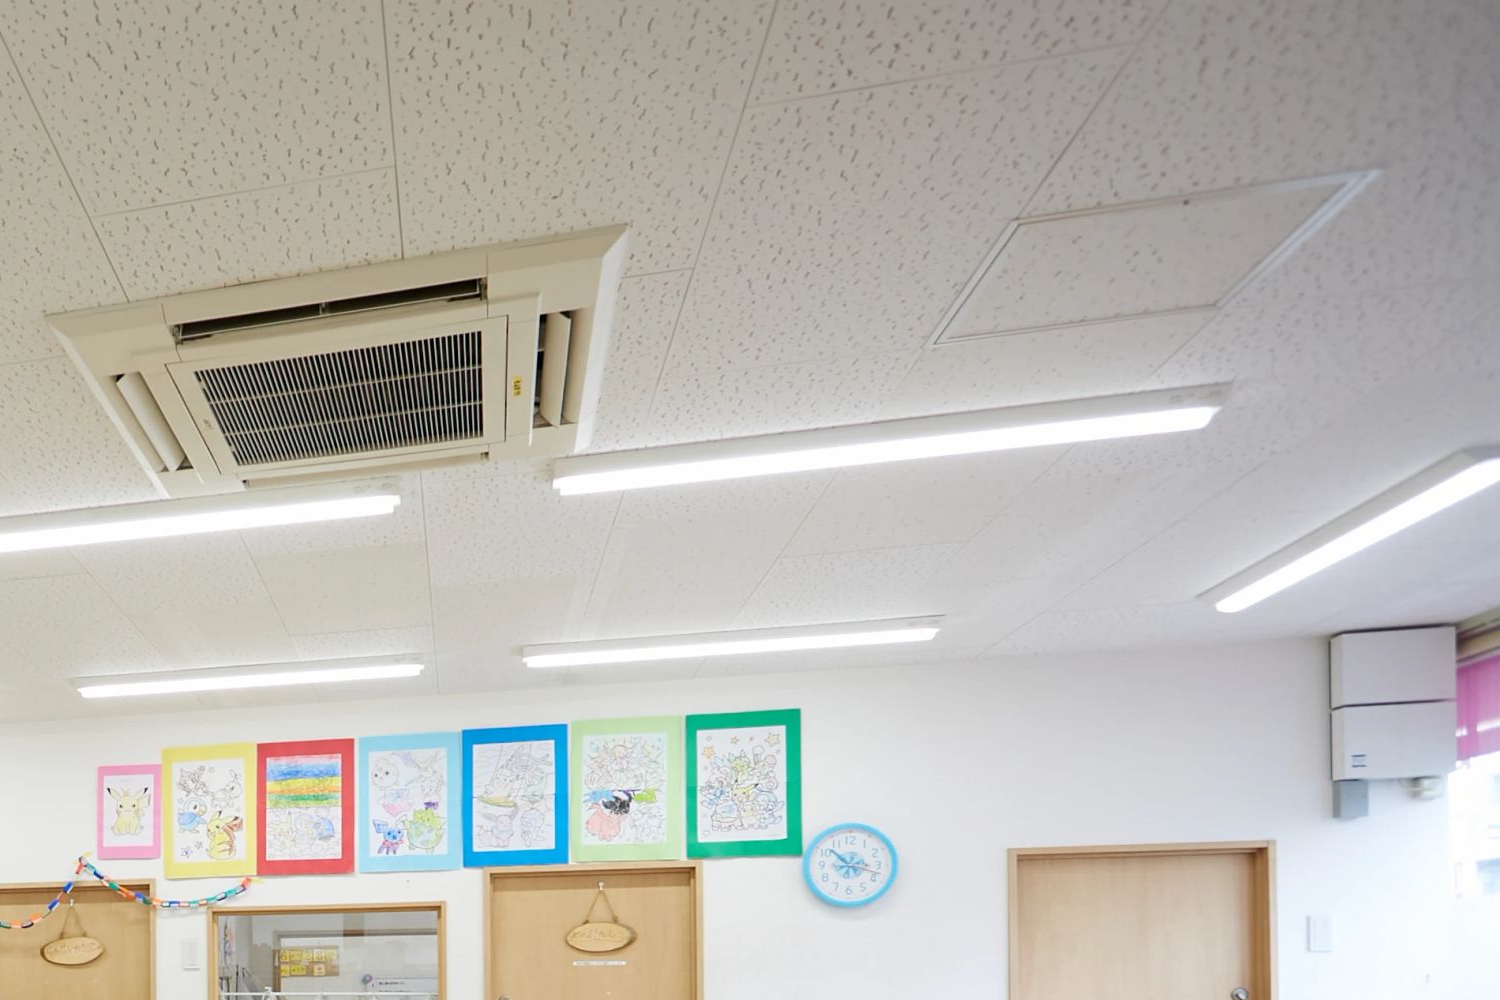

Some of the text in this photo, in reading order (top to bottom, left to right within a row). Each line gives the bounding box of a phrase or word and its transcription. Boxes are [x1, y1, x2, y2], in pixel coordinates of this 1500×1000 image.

[832, 839, 840, 848] 11
[845, 835, 856, 845] 12
[821, 848, 831, 857] 10
